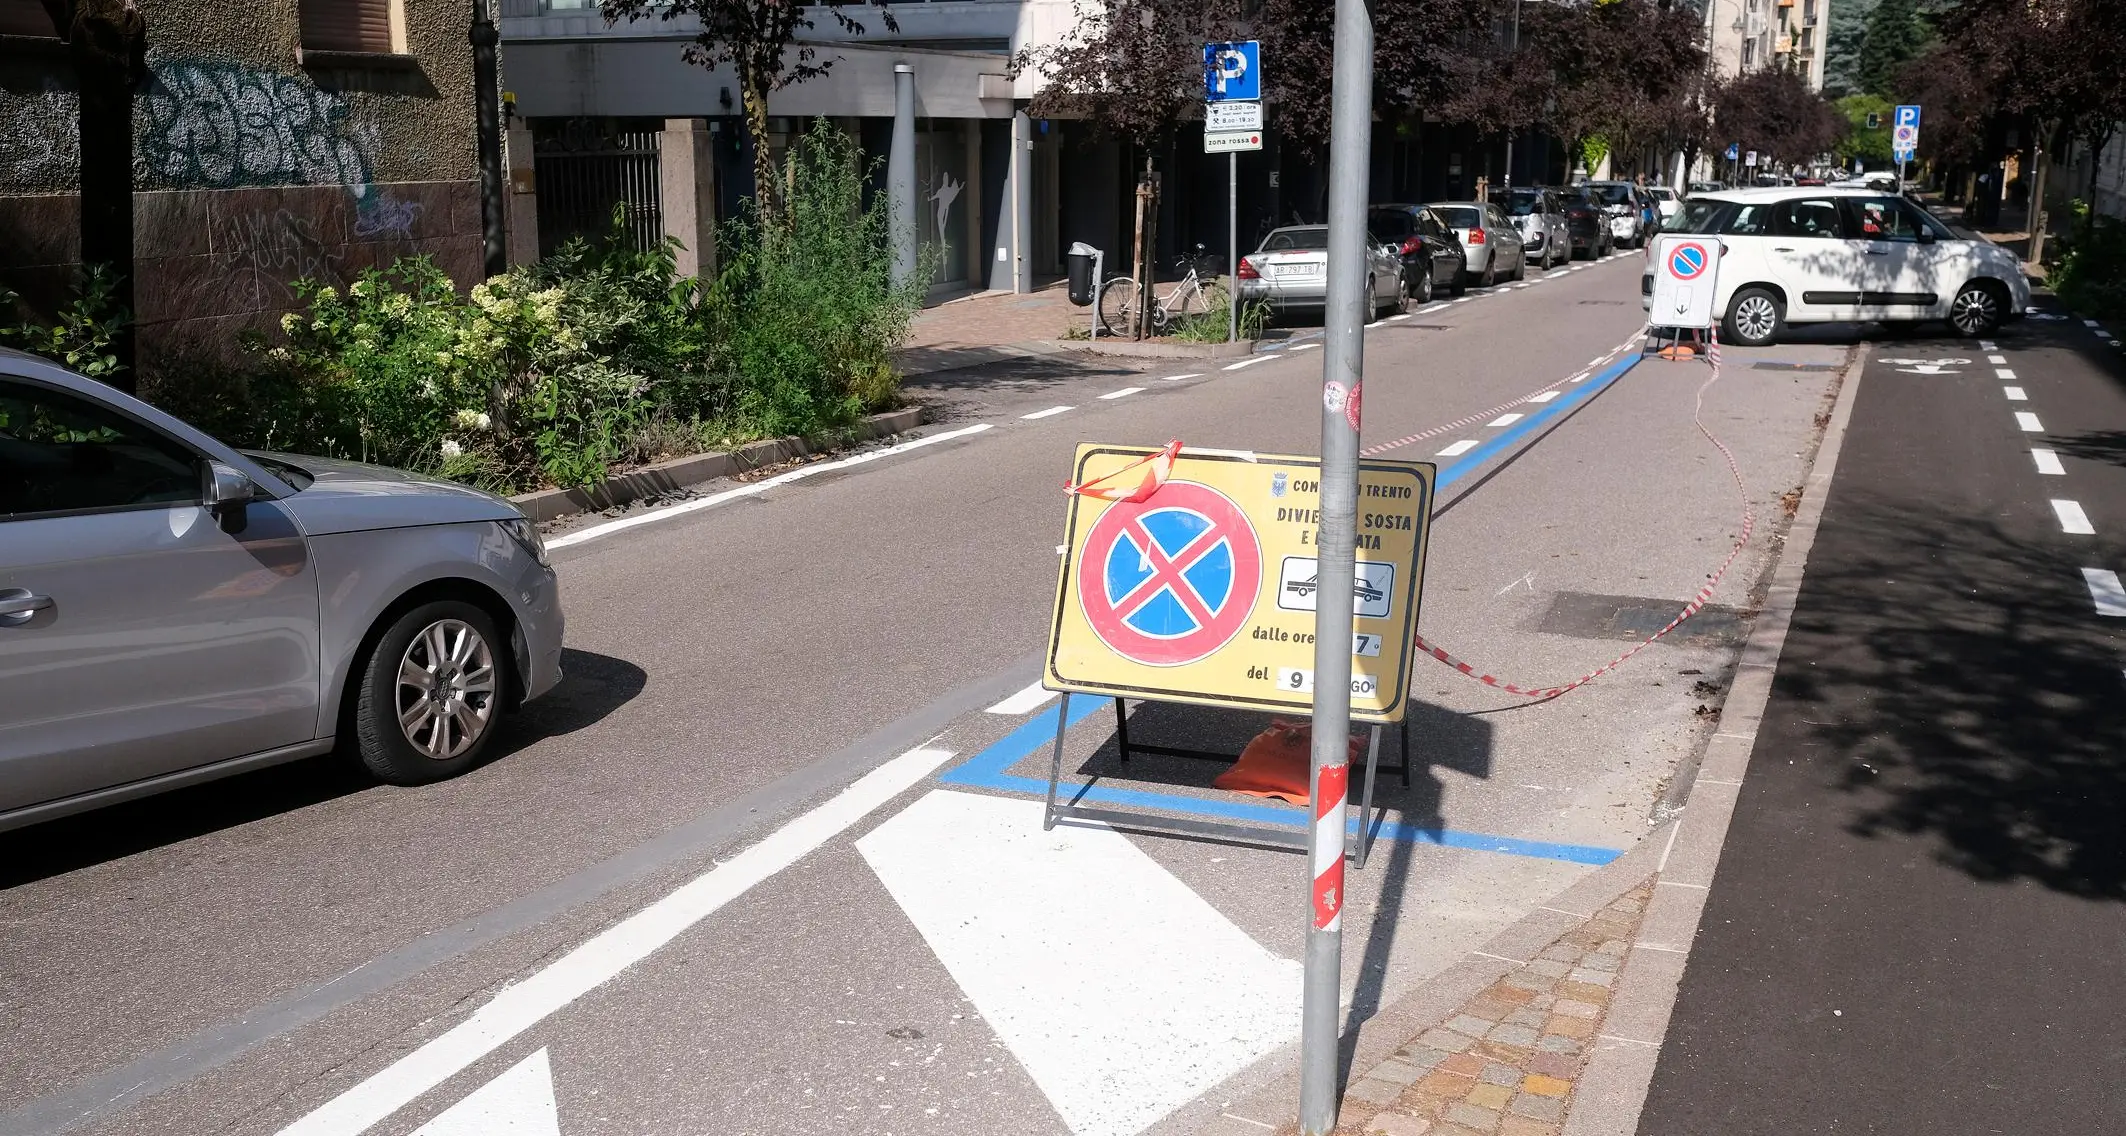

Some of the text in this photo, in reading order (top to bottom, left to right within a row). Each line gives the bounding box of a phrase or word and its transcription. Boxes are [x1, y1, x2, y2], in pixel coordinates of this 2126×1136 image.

[1216, 50, 1247, 92] P
[1900, 108, 1915, 126] P
[1366, 485, 1412, 499] TRENTO
[1277, 507, 1411, 531] DIVIE SOSTA
[1301, 530, 1309, 545] E
[1252, 626, 1370, 653] dalle ore 7
[1247, 665, 1269, 680] del
[1290, 671, 1304, 688] 9
